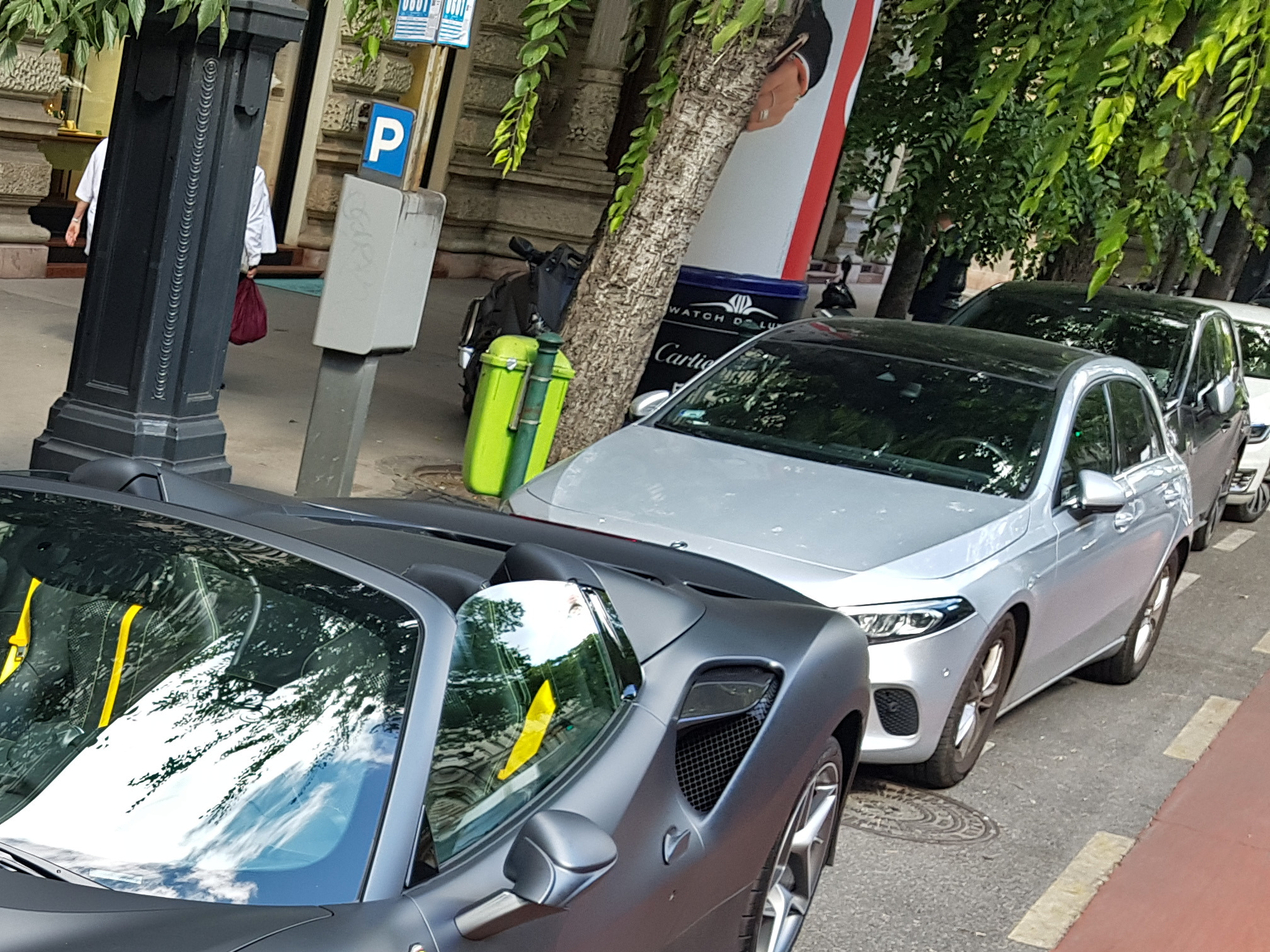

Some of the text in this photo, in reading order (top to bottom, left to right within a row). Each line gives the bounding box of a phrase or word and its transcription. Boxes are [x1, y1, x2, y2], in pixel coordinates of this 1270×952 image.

[369, 116, 405, 162] P
[669, 305, 725, 323] WATCH
[654, 342, 715, 370] Cartie
